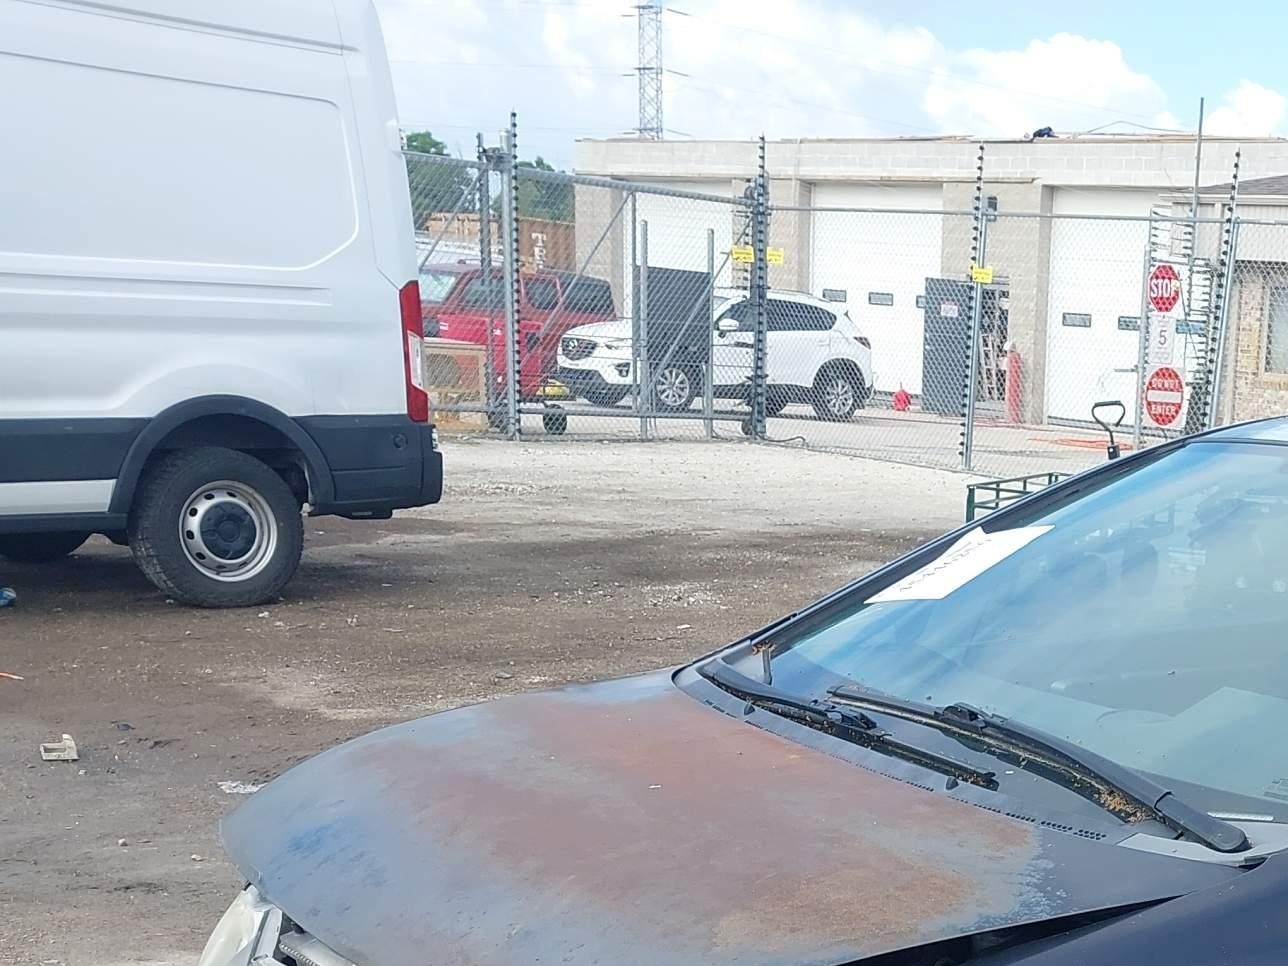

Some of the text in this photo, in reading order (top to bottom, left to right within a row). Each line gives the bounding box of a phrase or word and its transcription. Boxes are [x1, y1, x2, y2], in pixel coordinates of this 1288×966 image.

[1151, 278, 1181, 298] STOP
[1158, 329, 1167, 346] 5
[1151, 404, 1177, 415] ENTER
